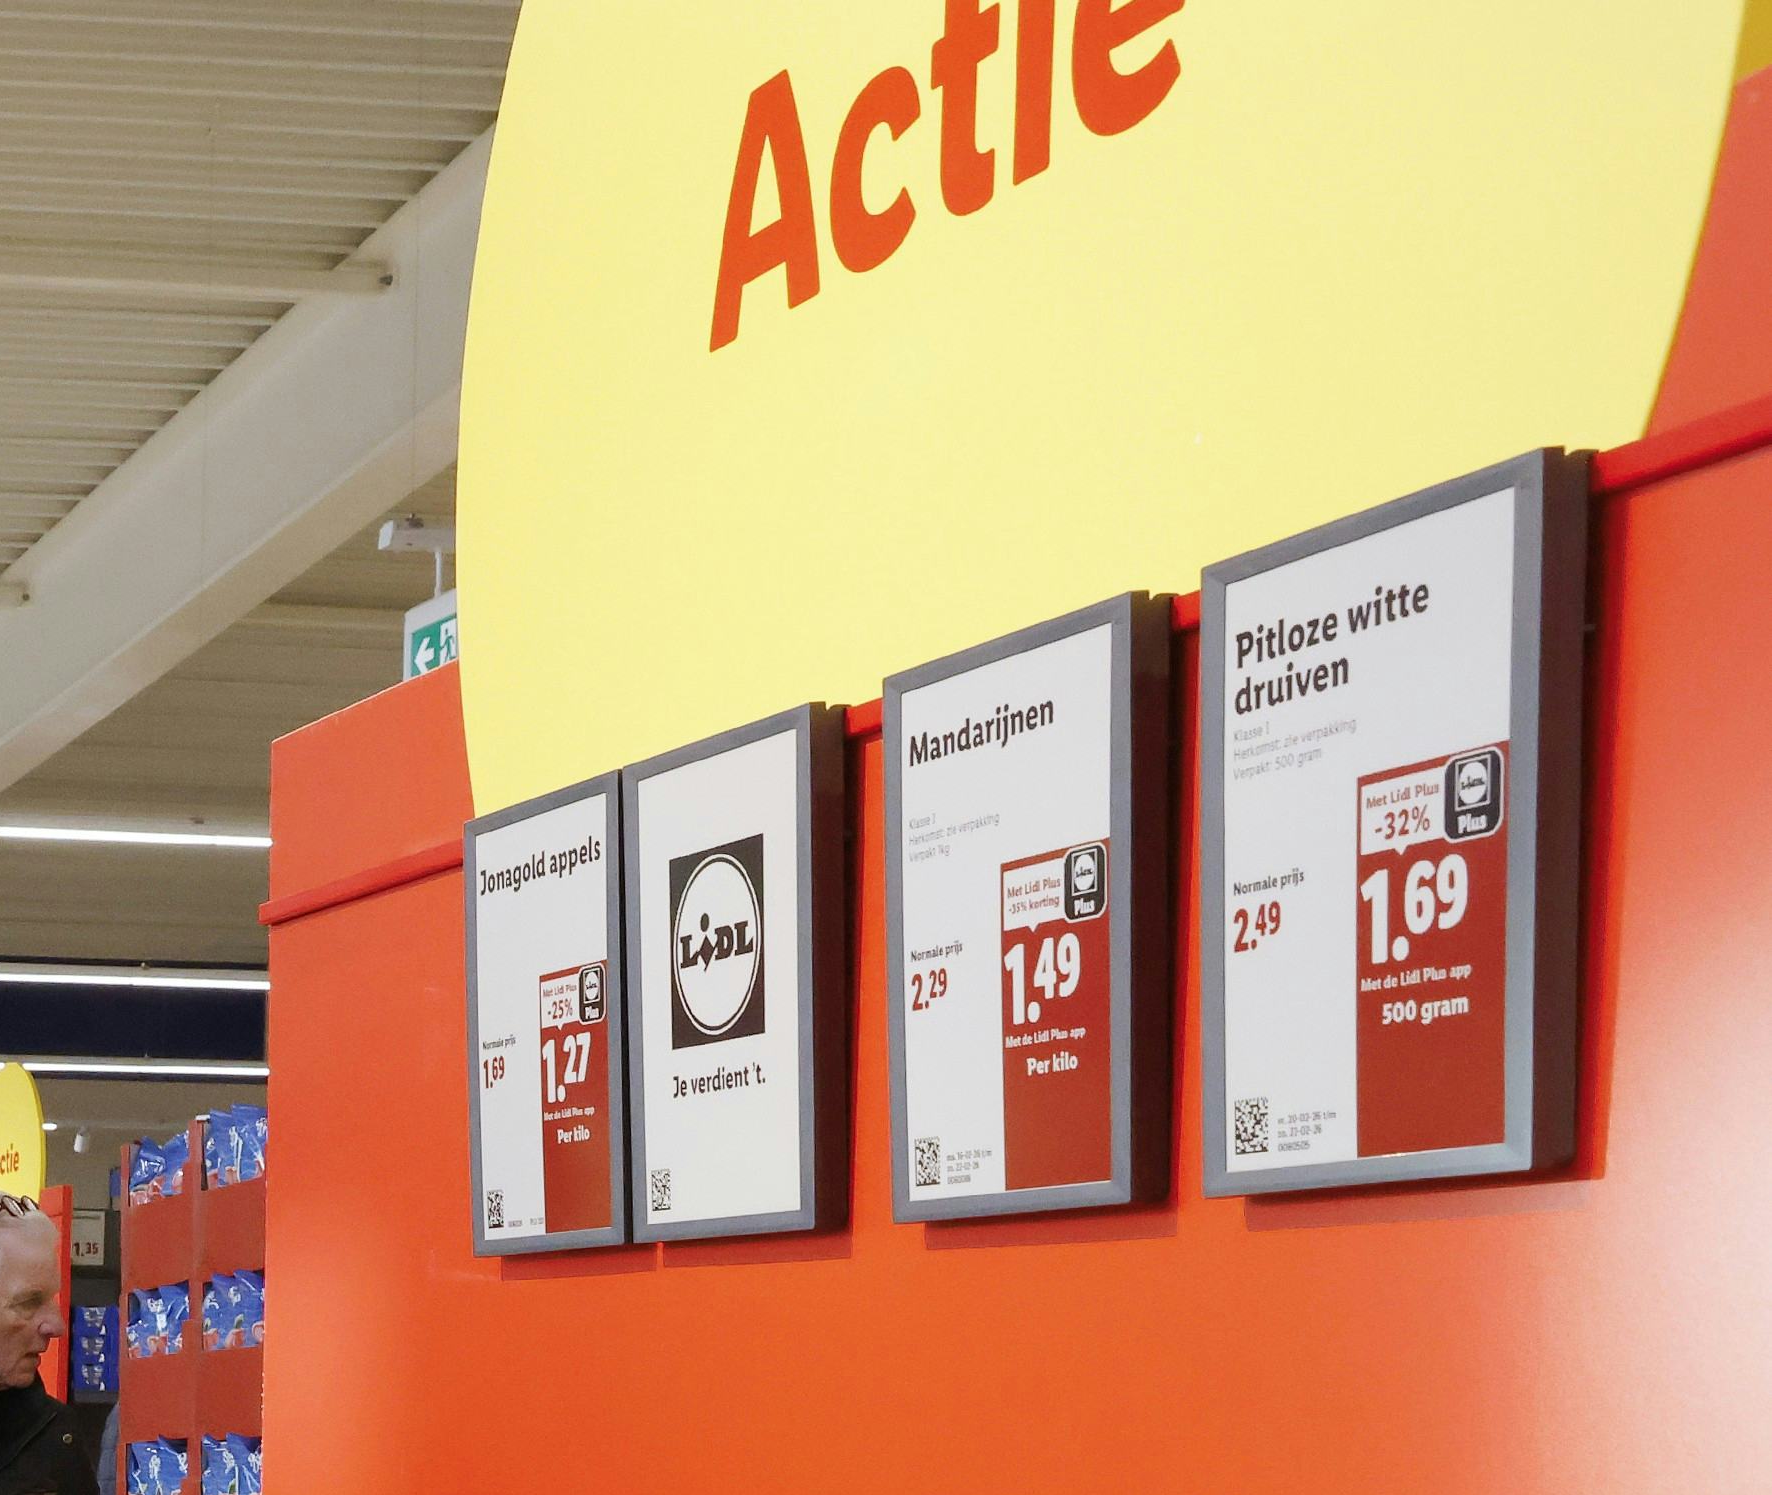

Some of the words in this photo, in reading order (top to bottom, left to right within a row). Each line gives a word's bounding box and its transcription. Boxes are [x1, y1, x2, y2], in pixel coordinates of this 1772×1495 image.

[708, 0, 1188, 353] Actie
[1236, 613, 1338, 669] Pitloze
[1347, 584, 1429, 633] witte
[1235, 657, 1349, 715] druiven
[909, 700, 1054, 767] Mandarijnen
[1297, 748, 1322, 767] gram
[1366, 796, 1387, 809] Met
[1390, 788, 1411, 804] Lidl
[1415, 783, 1439, 799] Plus
[1375, 804, 1430, 840] -32%
[1458, 814, 1486, 834] Plus
[480, 851, 546, 896] Jonagold
[550, 836, 601, 878] appels
[1234, 875, 1278, 896] Normale
[1280, 867, 1305, 890] prijs
[1007, 887, 1022, 899] Met
[1043, 878, 1061, 890] Plus
[1029, 895, 1060, 911] korting
[1234, 901, 1281, 953] 2.49
[1360, 854, 1469, 965] 1.69
[680, 912, 754, 972] LIDL
[911, 945, 944, 962] Normale
[945, 940, 963, 958] prijs
[911, 968, 947, 1011] 2.29
[1004, 932, 1081, 1025] 1.49
[1361, 978, 1382, 992] Met
[1384, 975, 1398, 988] de
[1400, 970, 1420, 987] Lidl
[1423, 967, 1446, 983] Plus
[1449, 964, 1472, 980] app
[1382, 1002, 1417, 1025] 500
[1420, 996, 1470, 1024] gram
[483, 1056, 505, 1089] 1.69
[542, 1032, 591, 1104] 1.27
[1027, 1057, 1049, 1076] Per
[1052, 1051, 1078, 1072] kilo
[673, 1076, 687, 1099] Je
[690, 1064, 750, 1095] verdient
[557, 1128, 573, 1144] Per
[573, 1125, 590, 1142] kilo
